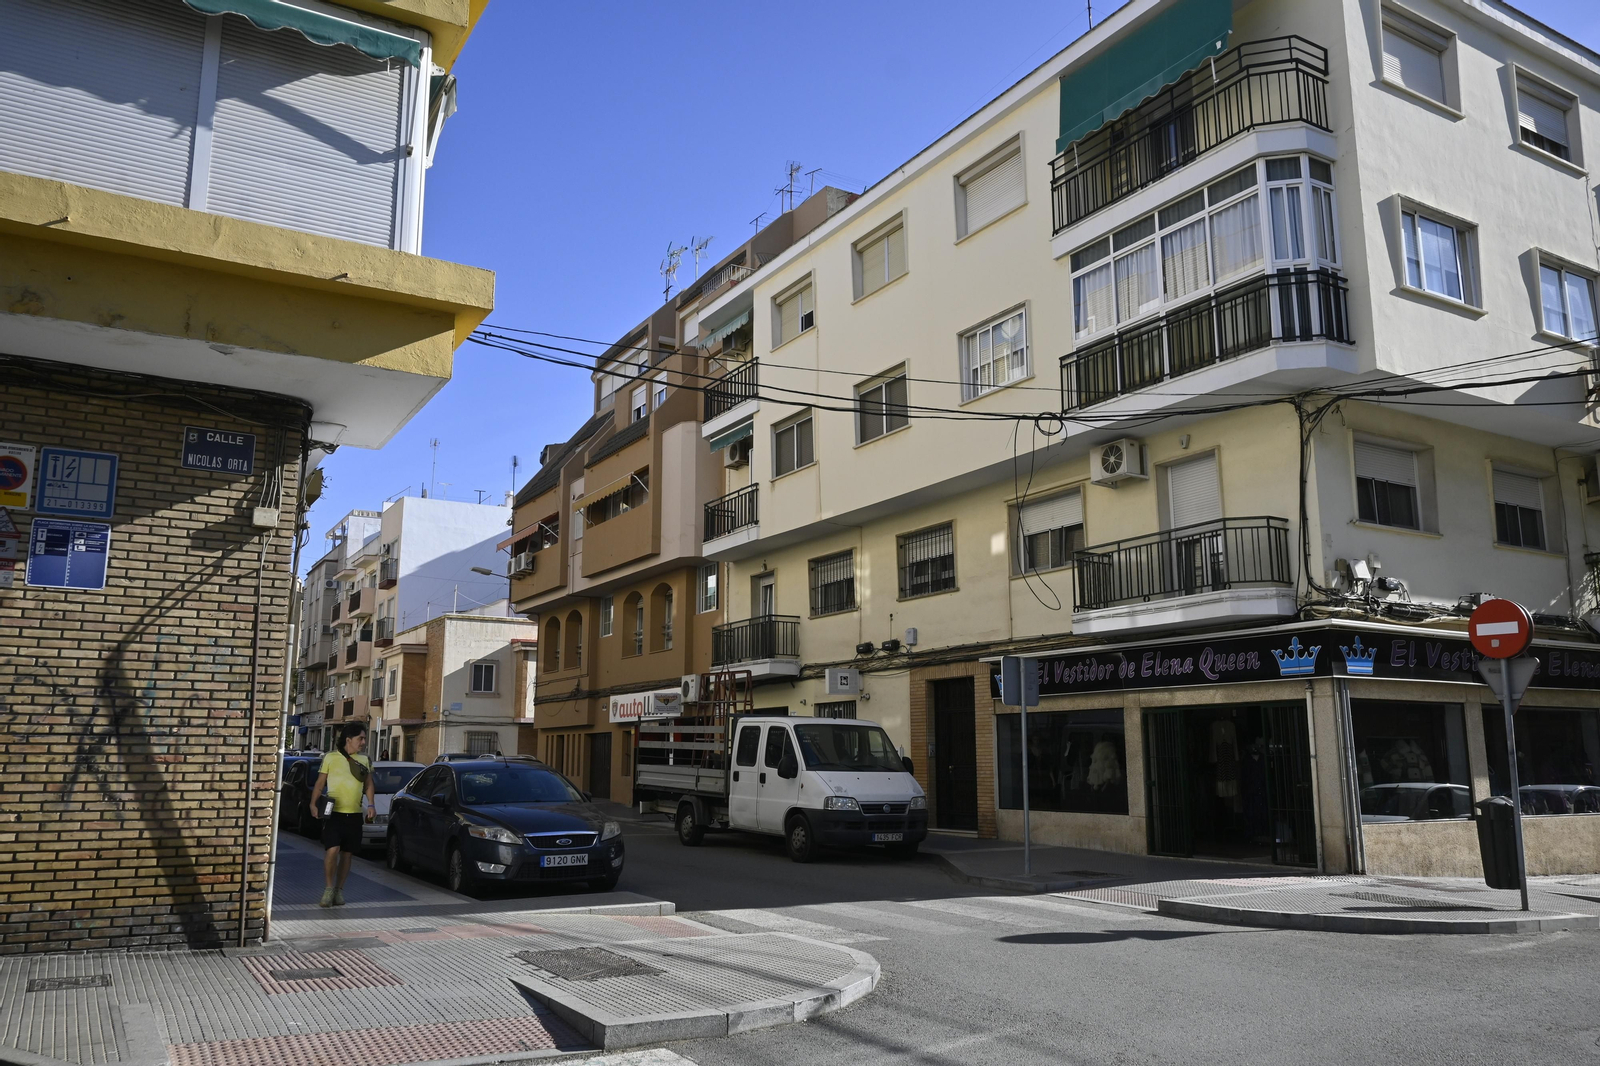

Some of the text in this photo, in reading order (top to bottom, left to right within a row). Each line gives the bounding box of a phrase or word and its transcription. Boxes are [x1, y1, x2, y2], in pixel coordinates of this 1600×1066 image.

[206, 432, 244, 446] CALLE
[187, 453, 248, 471] NICOLAS ORTA
[1390, 639, 1417, 668] El
[1425, 642, 1480, 672] Vesti
[1053, 657, 1115, 684] Vestidor
[1118, 654, 1136, 679] de
[1140, 650, 1194, 678] Elena
[1198, 646, 1261, 681] Queen
[546, 855, 587, 866] 9120 GNK
